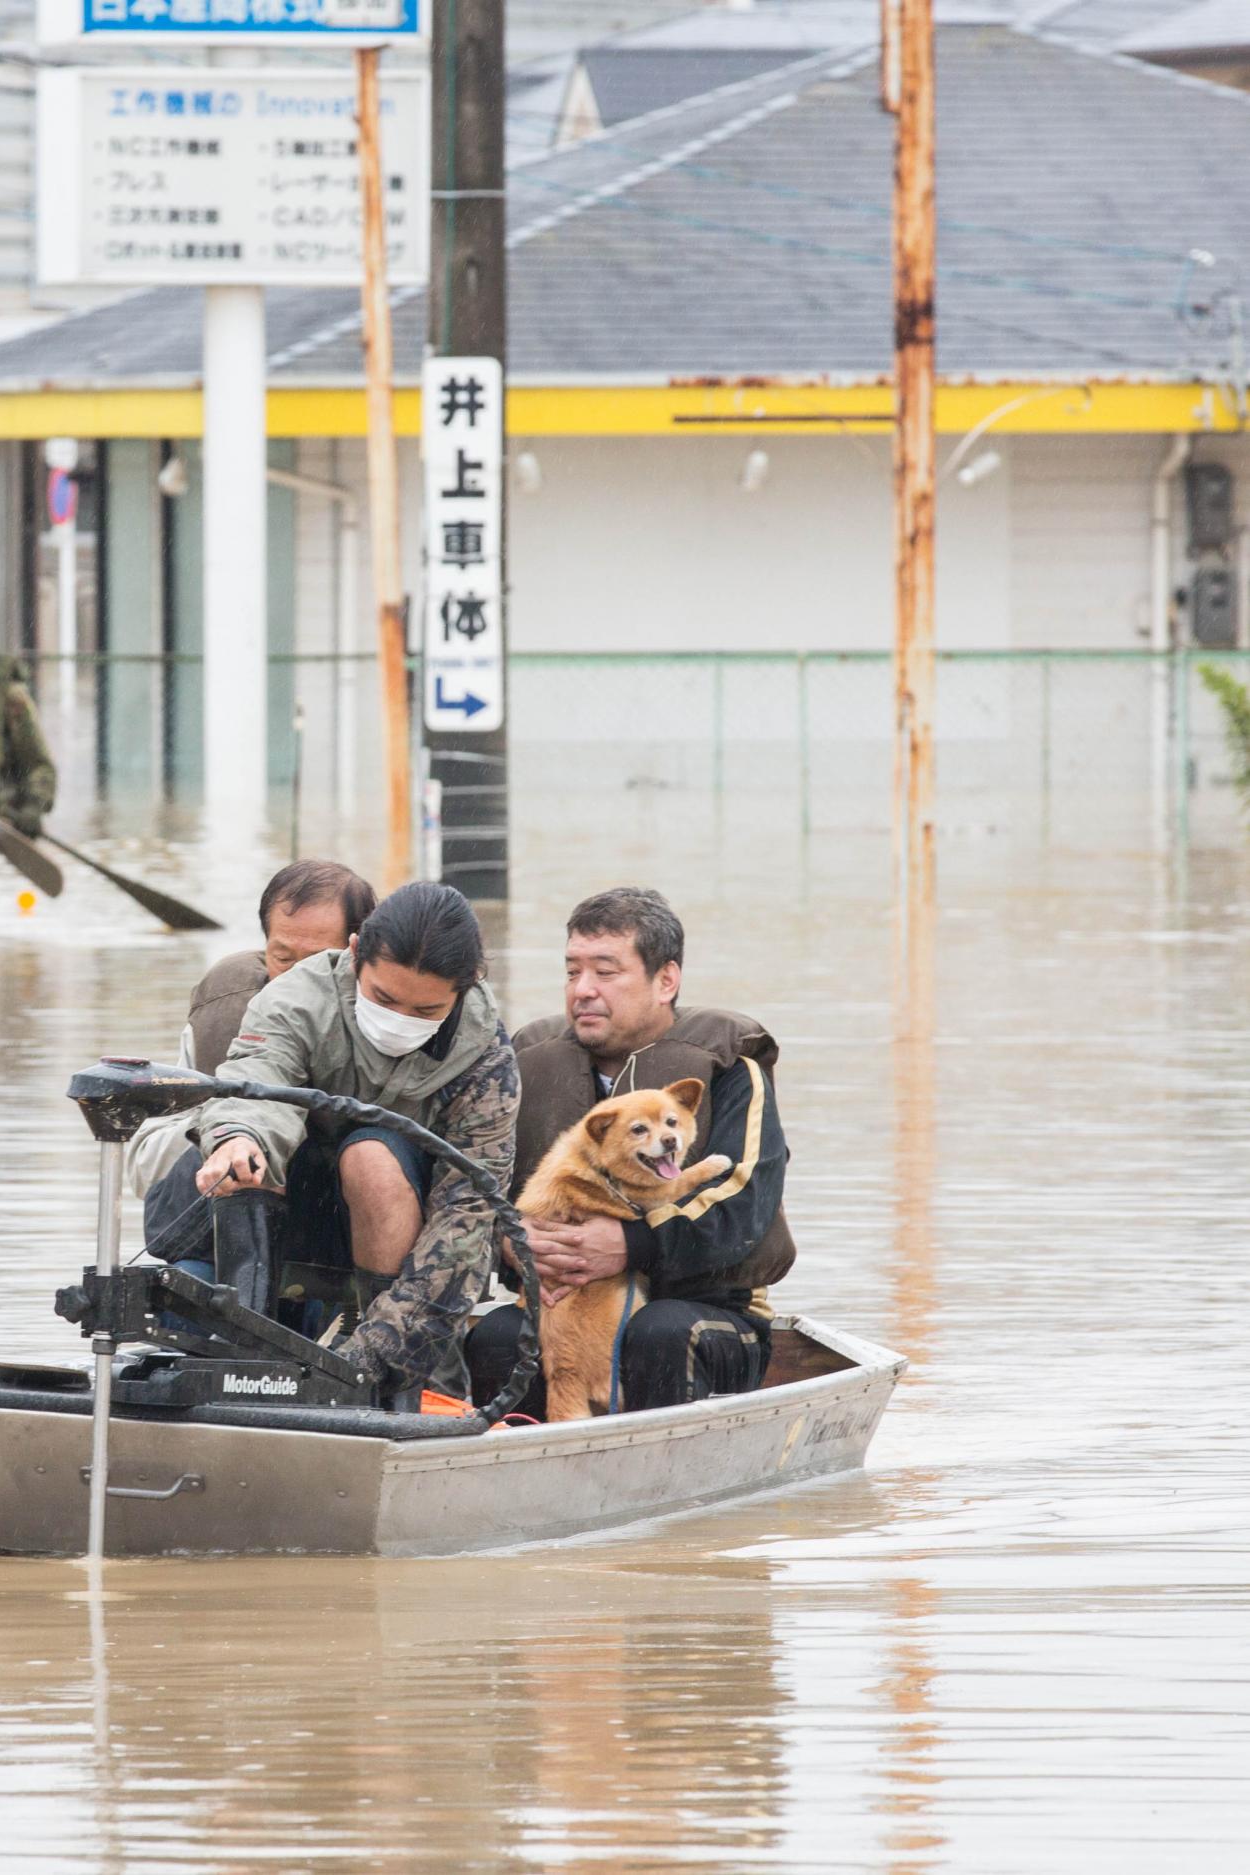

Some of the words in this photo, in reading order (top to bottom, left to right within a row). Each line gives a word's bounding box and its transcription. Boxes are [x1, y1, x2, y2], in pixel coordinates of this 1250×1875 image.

[440, 376, 487, 643] 井上車体
[222, 1374, 298, 1396] MotorGuide
